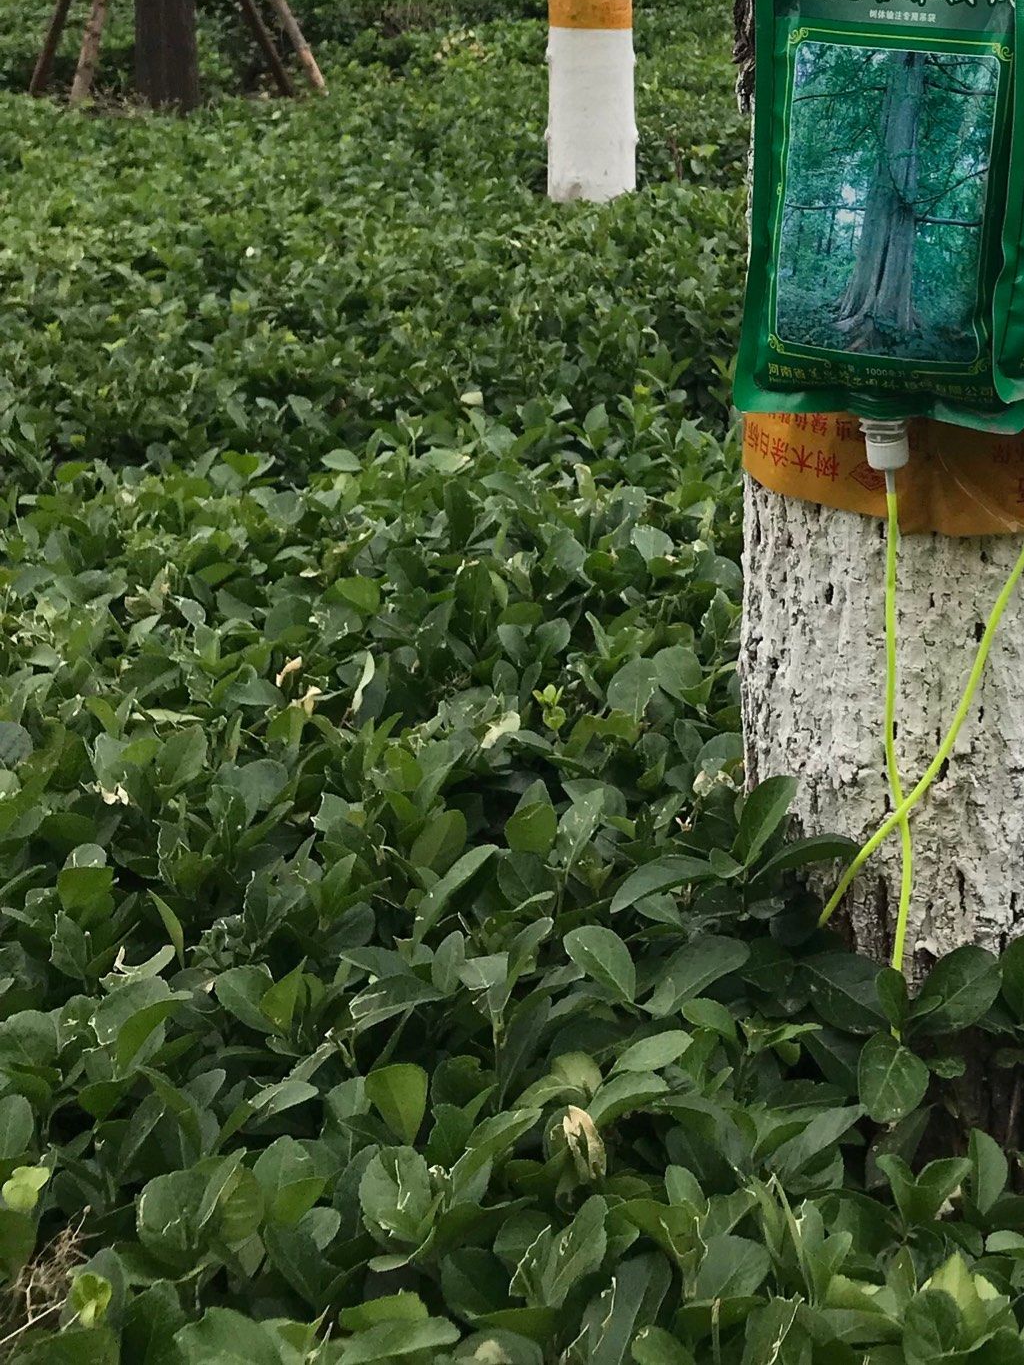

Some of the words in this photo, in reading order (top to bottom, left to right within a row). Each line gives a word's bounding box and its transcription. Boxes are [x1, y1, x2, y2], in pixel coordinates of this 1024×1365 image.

[743, 420, 840, 483] 树木涂白标
